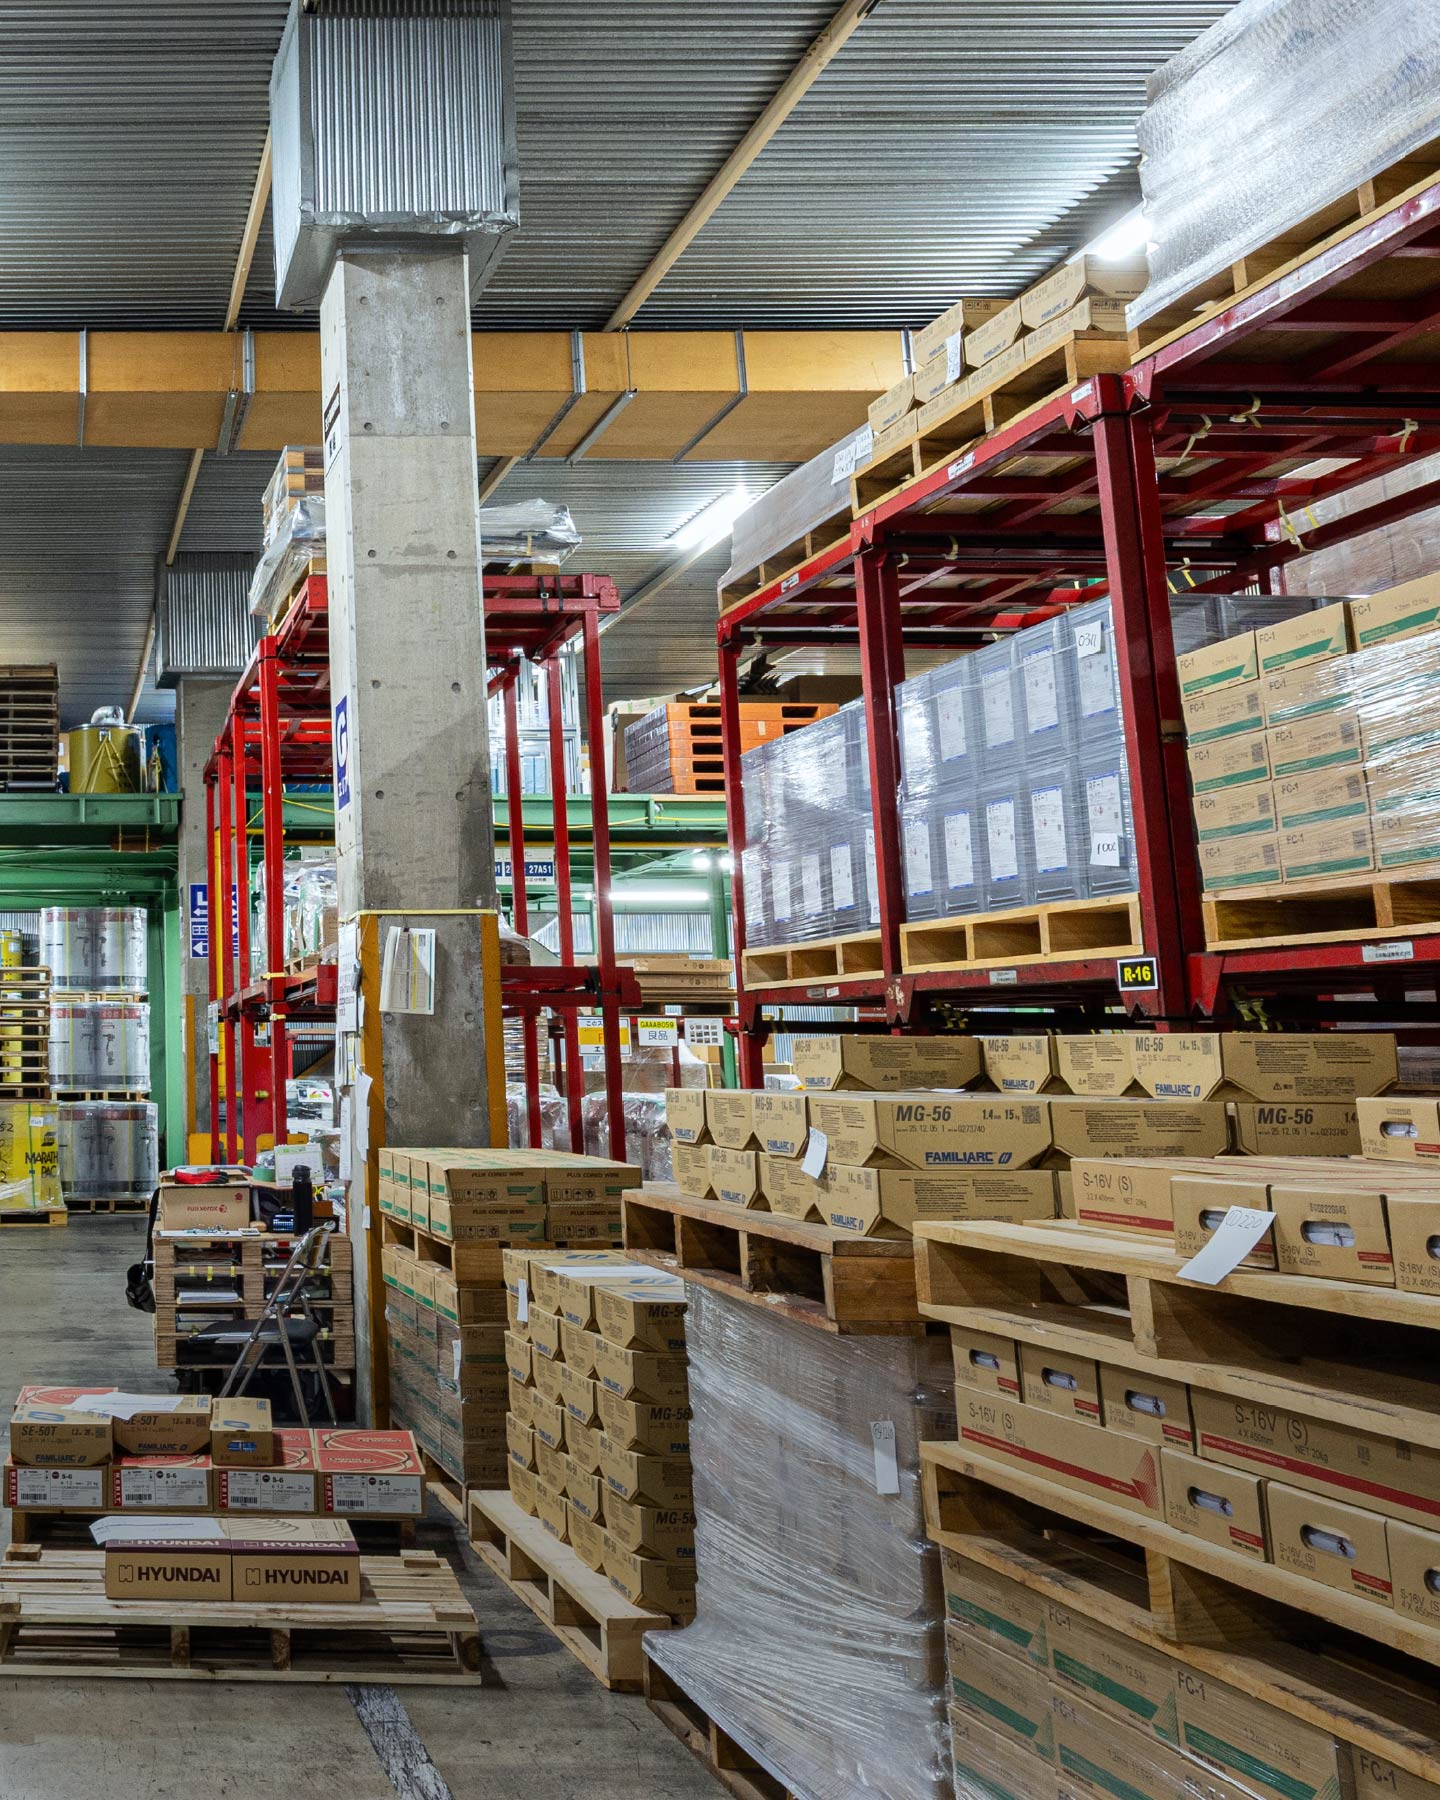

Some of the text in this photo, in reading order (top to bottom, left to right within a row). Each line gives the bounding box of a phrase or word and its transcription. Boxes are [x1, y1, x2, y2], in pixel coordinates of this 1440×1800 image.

[1352, 604, 1372, 616] FC-1
[1078, 632, 1097, 648] 0311
[1260, 632, 1276, 642] FC-1
[1180, 660, 1195, 669] FC-1
[1190, 703, 1205, 712] FC-1
[337, 711, 347, 767] G
[1275, 731, 1293, 742] FC-1
[1194, 752, 1210, 761] FC-1
[1282, 784, 1299, 793] FC-1
[1200, 800, 1216, 809] FC-1
[1286, 834, 1304, 843] FC-1
[529, 865, 551, 873] 27A51
[1122, 965, 1152, 985] R-16
[648, 1031, 668, 1041] 良品
[794, 1039, 812, 1053] MG-56
[988, 1039, 1009, 1052] MG-56
[1135, 1037, 1164, 1052] MG-56
[1002, 1078, 1027, 1090] FAMILIARC
[1155, 1082, 1192, 1097] FAMILIARC
[896, 1105, 952, 1121] MG-56
[1258, 1108, 1313, 1125] MG-56
[767, 1139, 789, 1153] FAMILIARC
[25, 1152, 58, 1164] MARATH
[925, 1151, 994, 1165] FAMILIARC
[41, 1165, 57, 1178] PAC
[1083, 1171, 1134, 1194] S-16V (S)
[721, 1189, 741, 1203] FAMILIARC
[831, 1213, 857, 1230] FAMILIARC
[1178, 1230, 1196, 1241] S-16V
[1280, 1244, 1316, 1258] S-16V (S)
[1400, 1262, 1423, 1274] S-16V
[648, 1304, 687, 1318] MG-56
[650, 1407, 691, 1420] MG-56
[969, 1403, 1015, 1431] S-16V (S)
[21, 1425, 58, 1437] SE-50T
[1235, 1404, 1308, 1446] S-16V (S)
[138, 1443, 178, 1451] FAMILIARC
[35, 1454, 76, 1463] FAMILIARC
[1295, 1445, 1329, 1464] NET 20kg
[9, 1471, 17, 1503] MERIT
[114, 1471, 122, 1505] MERIT
[220, 1473, 228, 1507] MERIT
[325, 1476, 333, 1510] MERIT
[656, 1511, 696, 1525] MG-56
[1279, 1542, 1316, 1564] S-16V (S)
[138, 1566, 221, 1582] HYUNDAI
[265, 1569, 349, 1584] HYUNDAI
[1400, 1588, 1425, 1604] S-16V
[1049, 1605, 1072, 1632] FC-1
[1176, 1671, 1206, 1701] FC-1
[1361, 1756, 1396, 1790] FC-1
